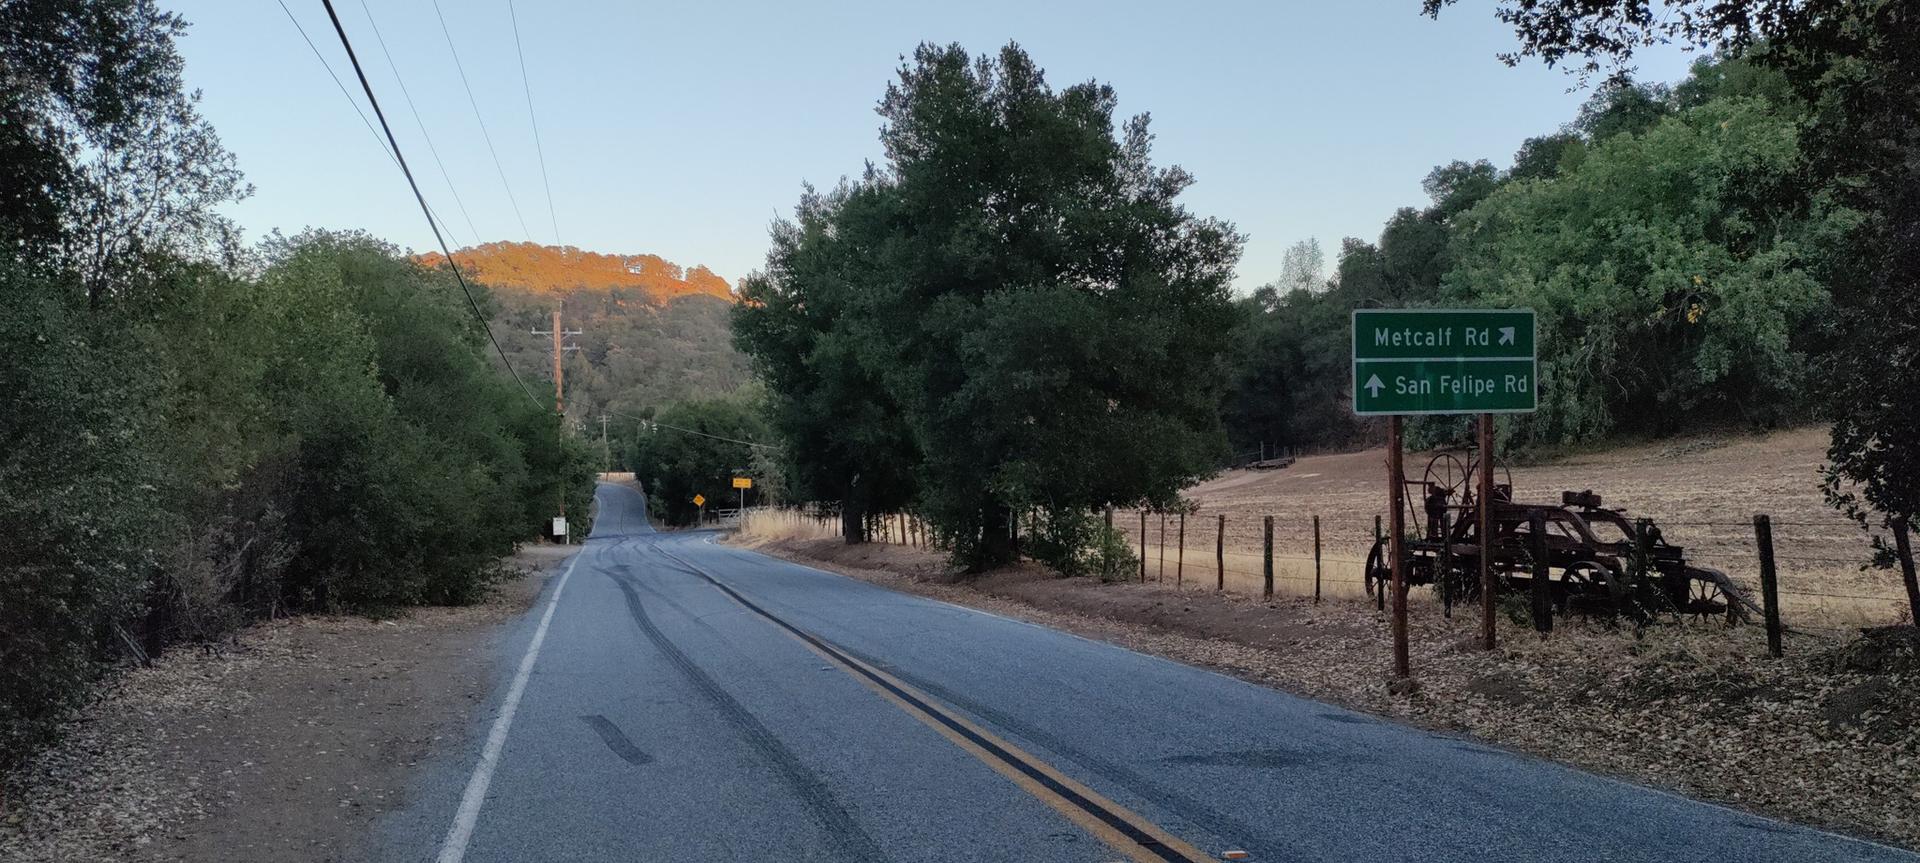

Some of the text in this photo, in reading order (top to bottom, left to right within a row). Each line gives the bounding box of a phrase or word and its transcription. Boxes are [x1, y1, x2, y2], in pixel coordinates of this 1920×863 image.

[1375, 327, 1489, 346] Metcalf Rd
[1396, 374, 1527, 397] San Felipe Rd
